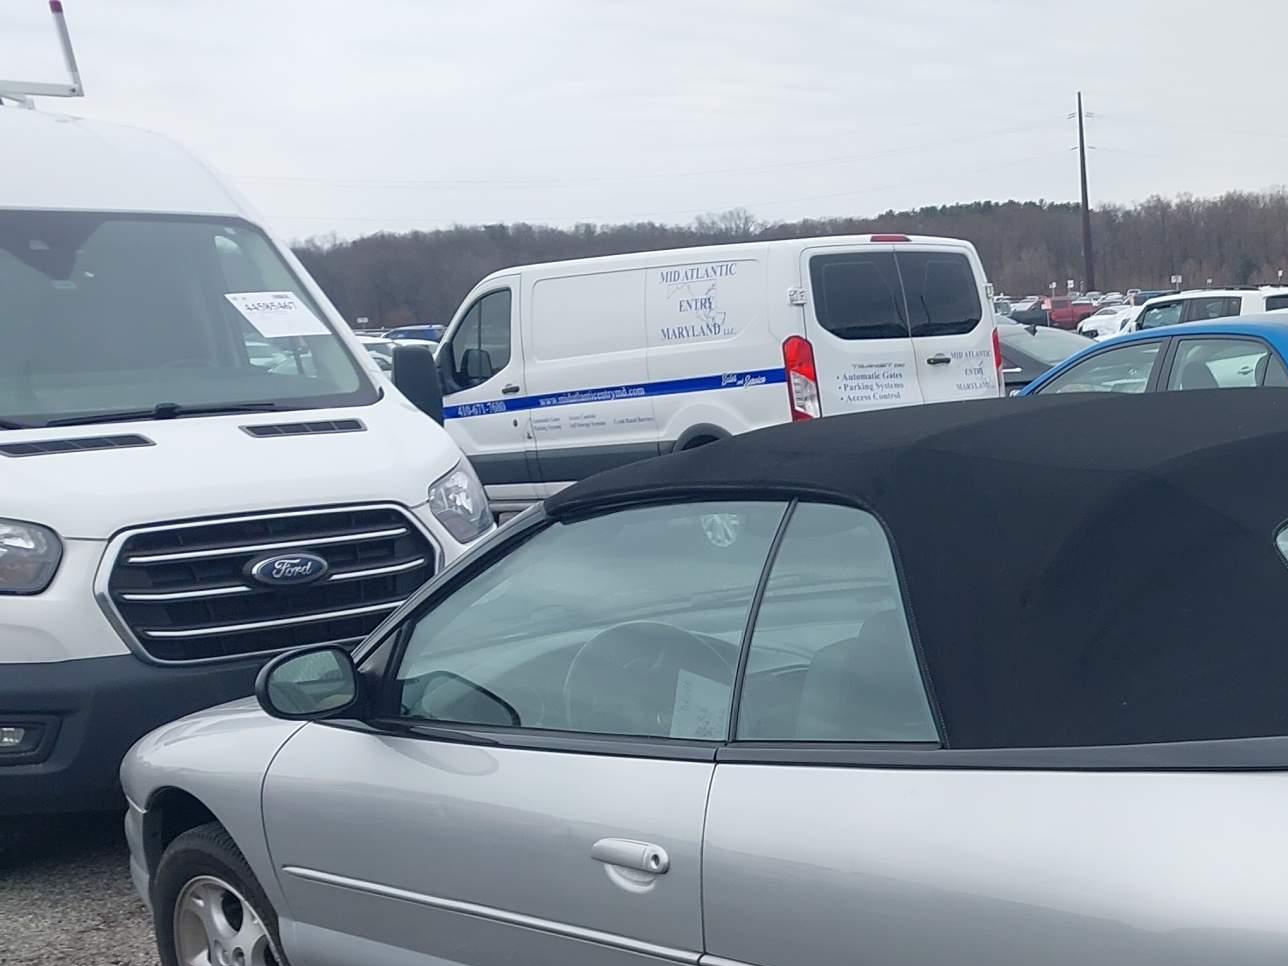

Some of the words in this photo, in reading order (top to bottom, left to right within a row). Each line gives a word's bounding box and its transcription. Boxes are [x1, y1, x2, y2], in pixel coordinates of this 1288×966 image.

[660, 269, 680, 283] MID
[682, 262, 737, 281] ATLANTIC
[679, 296, 713, 313] ENTRY
[660, 322, 721, 340] MARYLAND
[842, 373, 880, 381] Automatic
[882, 371, 903, 380] Gates
[843, 383, 874, 392] Parking
[875, 382, 905, 392] Systems
[846, 394, 871, 402] Access
[272, 559, 312, 578] Ford
